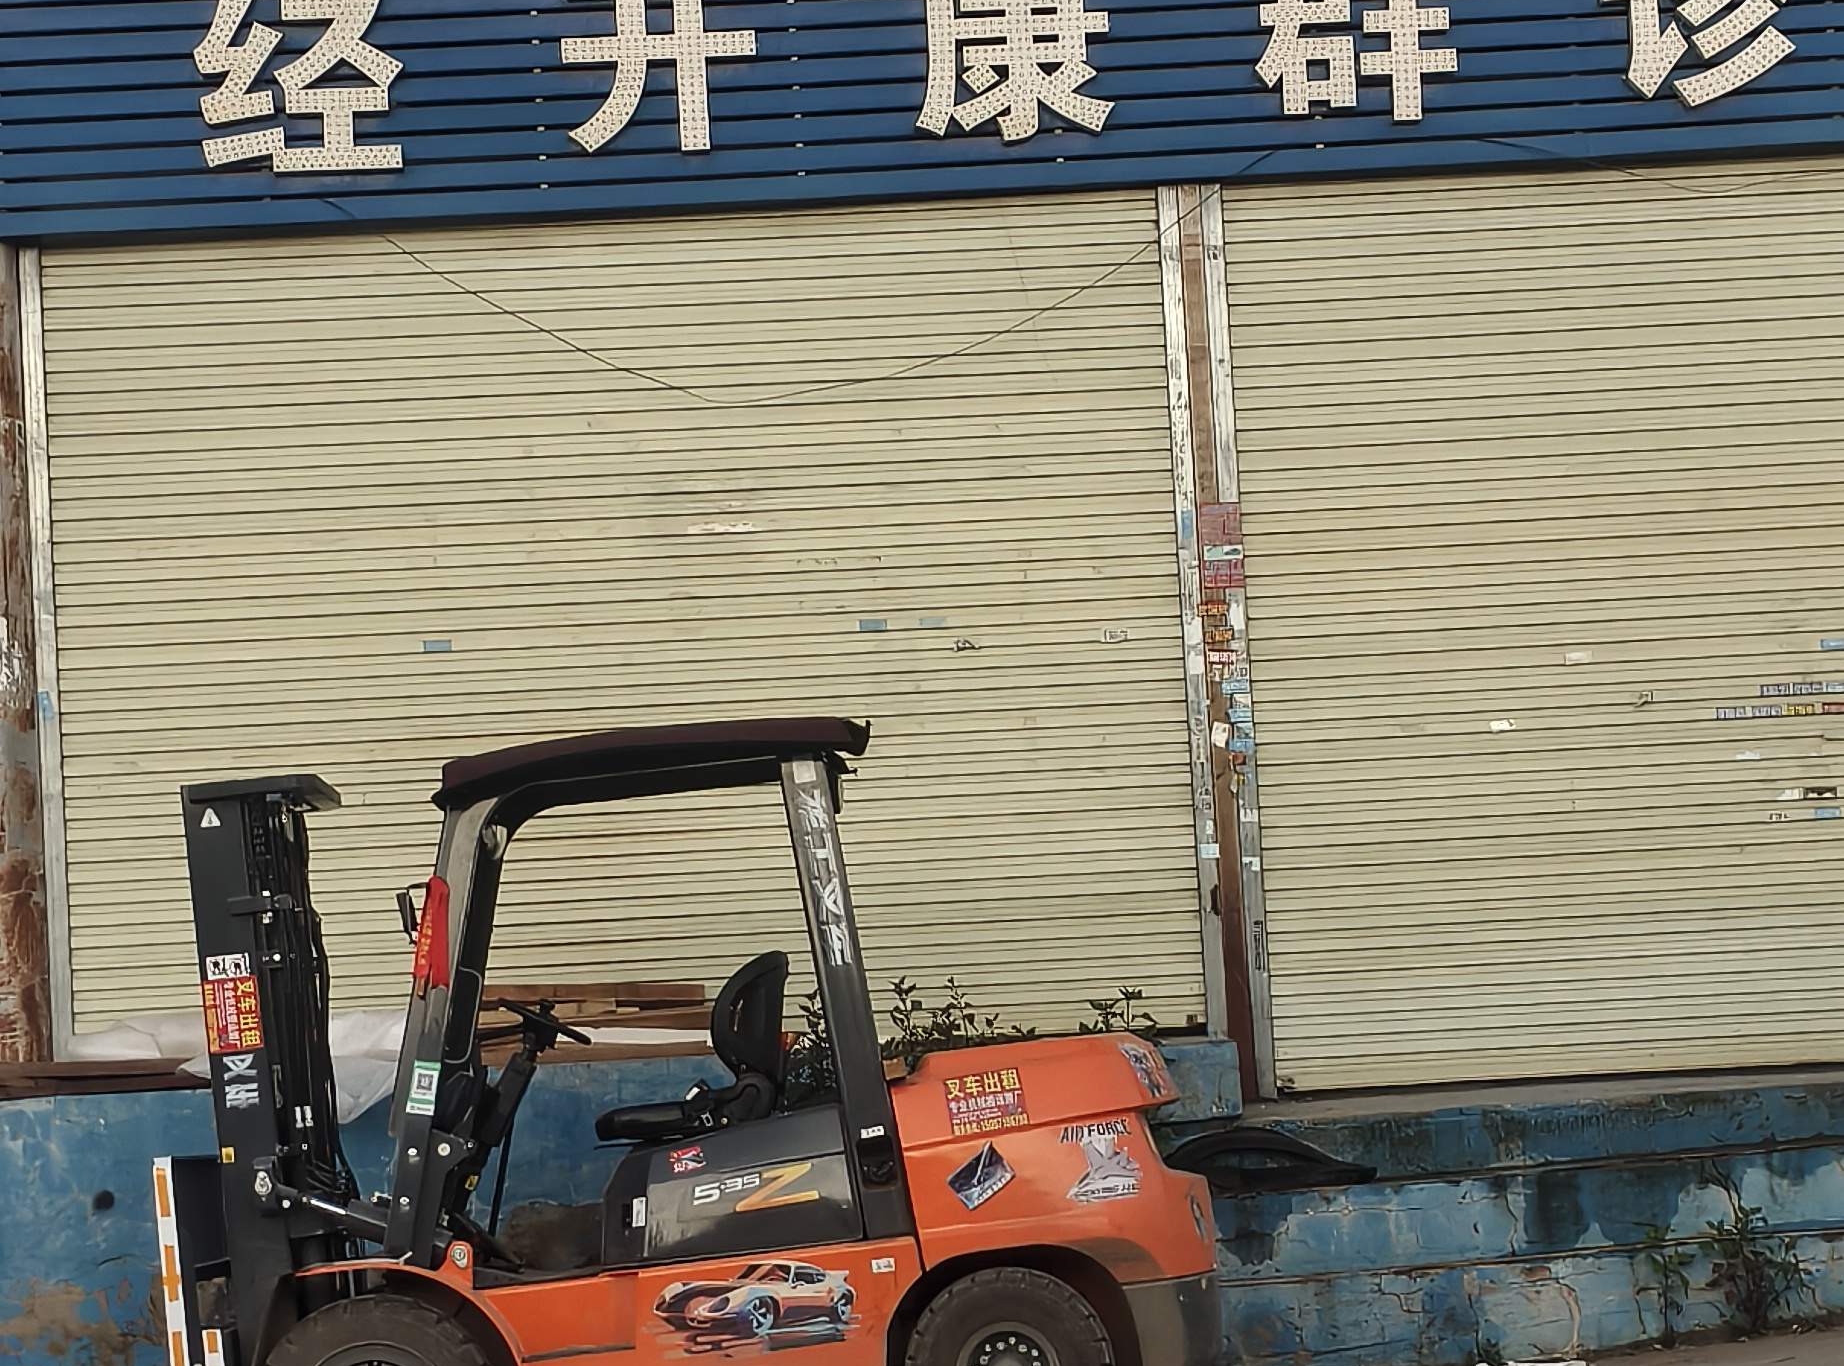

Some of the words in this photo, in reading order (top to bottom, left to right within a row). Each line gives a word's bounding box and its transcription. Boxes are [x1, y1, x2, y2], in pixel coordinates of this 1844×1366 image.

[236, 978, 261, 1048] 叉车出租
[944, 1069, 1021, 1099] 叉车出租
